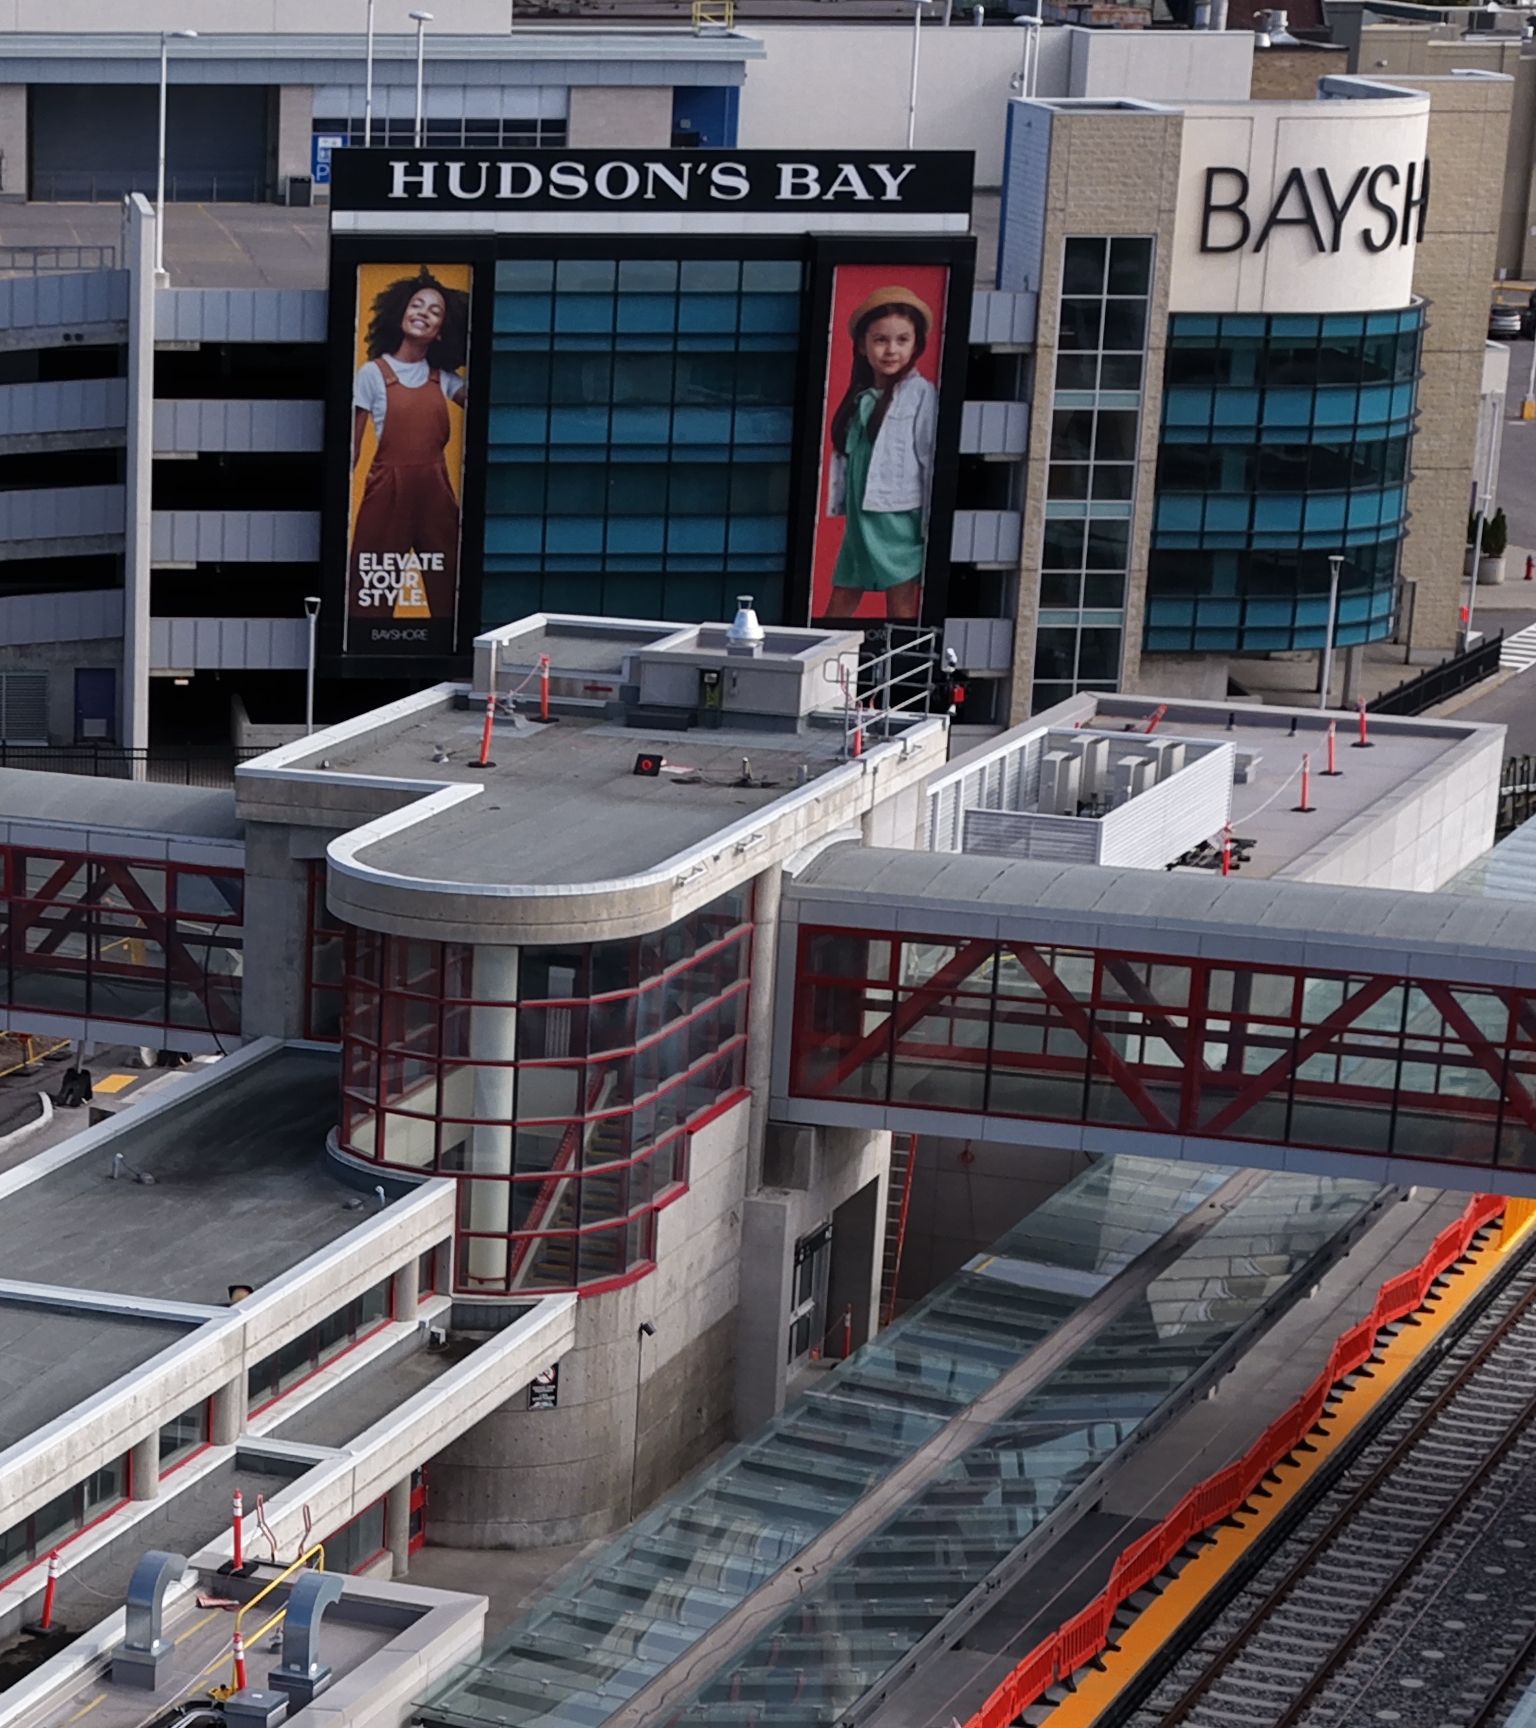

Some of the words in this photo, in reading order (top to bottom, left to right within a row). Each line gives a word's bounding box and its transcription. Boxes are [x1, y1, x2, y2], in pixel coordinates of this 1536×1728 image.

[388, 161, 750, 200] HUDSON'S
[775, 163, 916, 202] BAY
[359, 552, 444, 571] ELEVATE
[359, 571, 418, 588] YOUR
[359, 588, 427, 606] STYLE.
[371, 629, 428, 641] BAYSHORE
